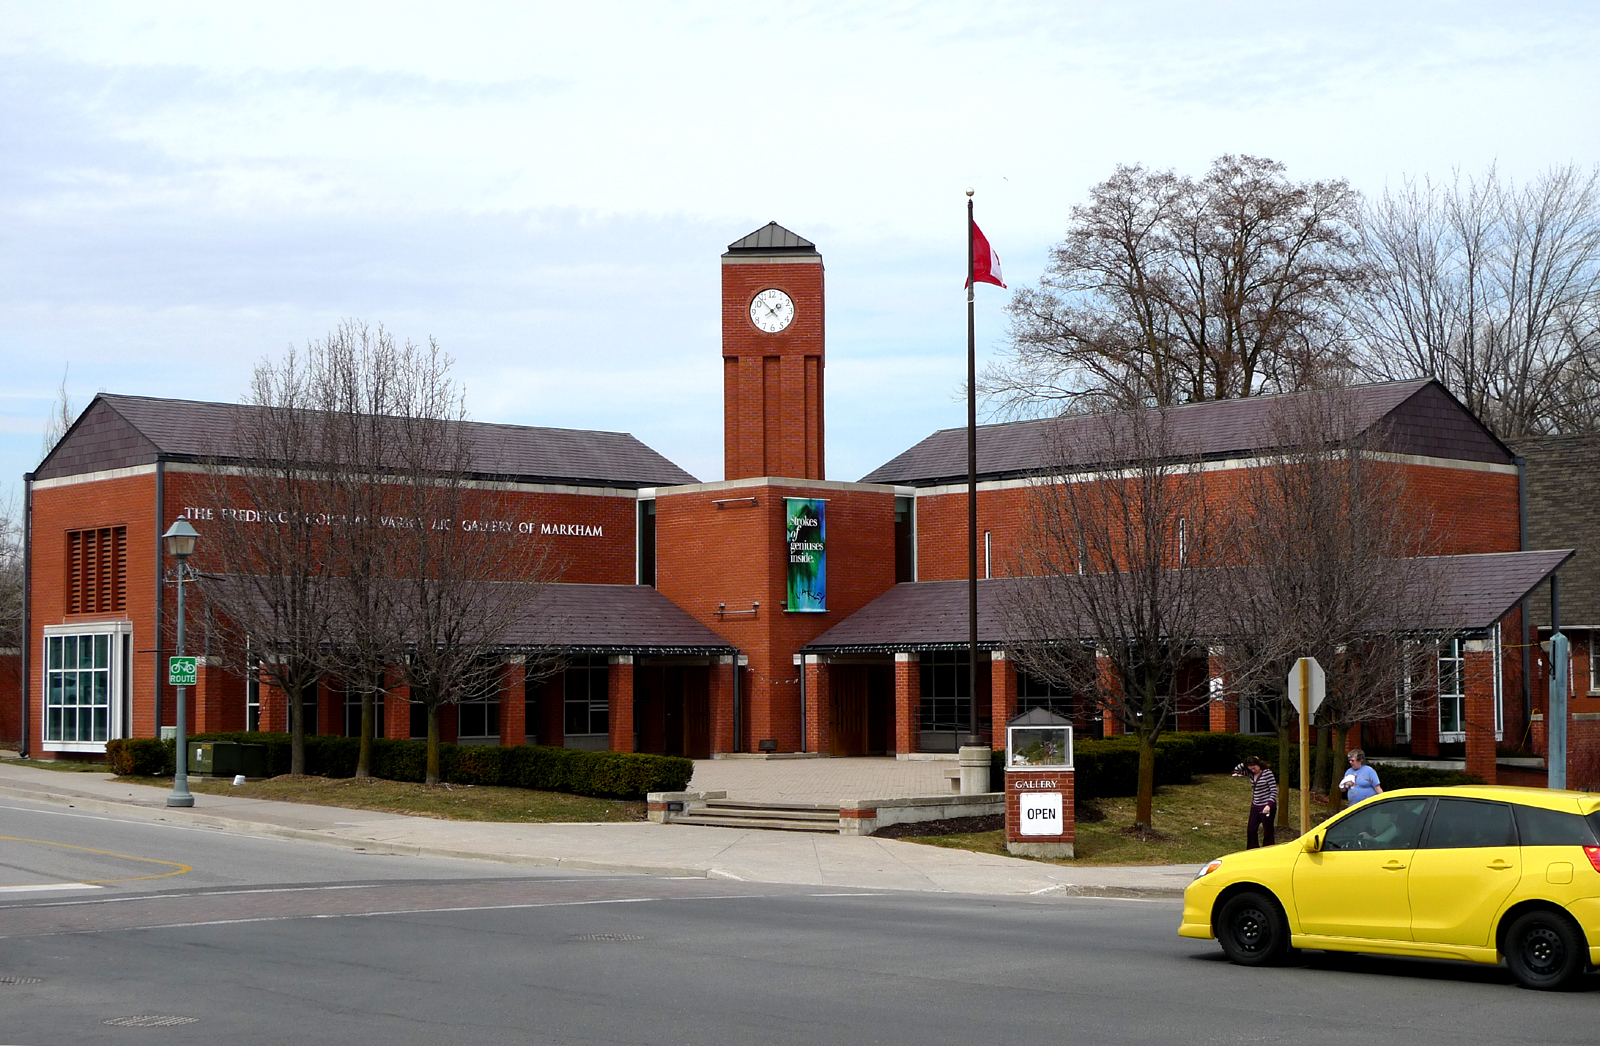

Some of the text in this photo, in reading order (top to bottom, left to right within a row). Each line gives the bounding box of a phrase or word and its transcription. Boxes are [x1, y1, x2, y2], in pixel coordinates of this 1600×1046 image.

[785, 299, 790, 307] 2
[184, 506, 214, 520] THE
[518, 521, 535, 534] OF
[540, 523, 603, 537] MARKHAM
[790, 515, 818, 527] Strokes
[790, 525, 802, 541] of
[790, 540, 824, 554] geniuses
[790, 552, 815, 563] inside.
[170, 675, 195, 683] ROUTE
[1015, 780, 1058, 789] GALLERY
[1027, 808, 1056, 820] OPEN
